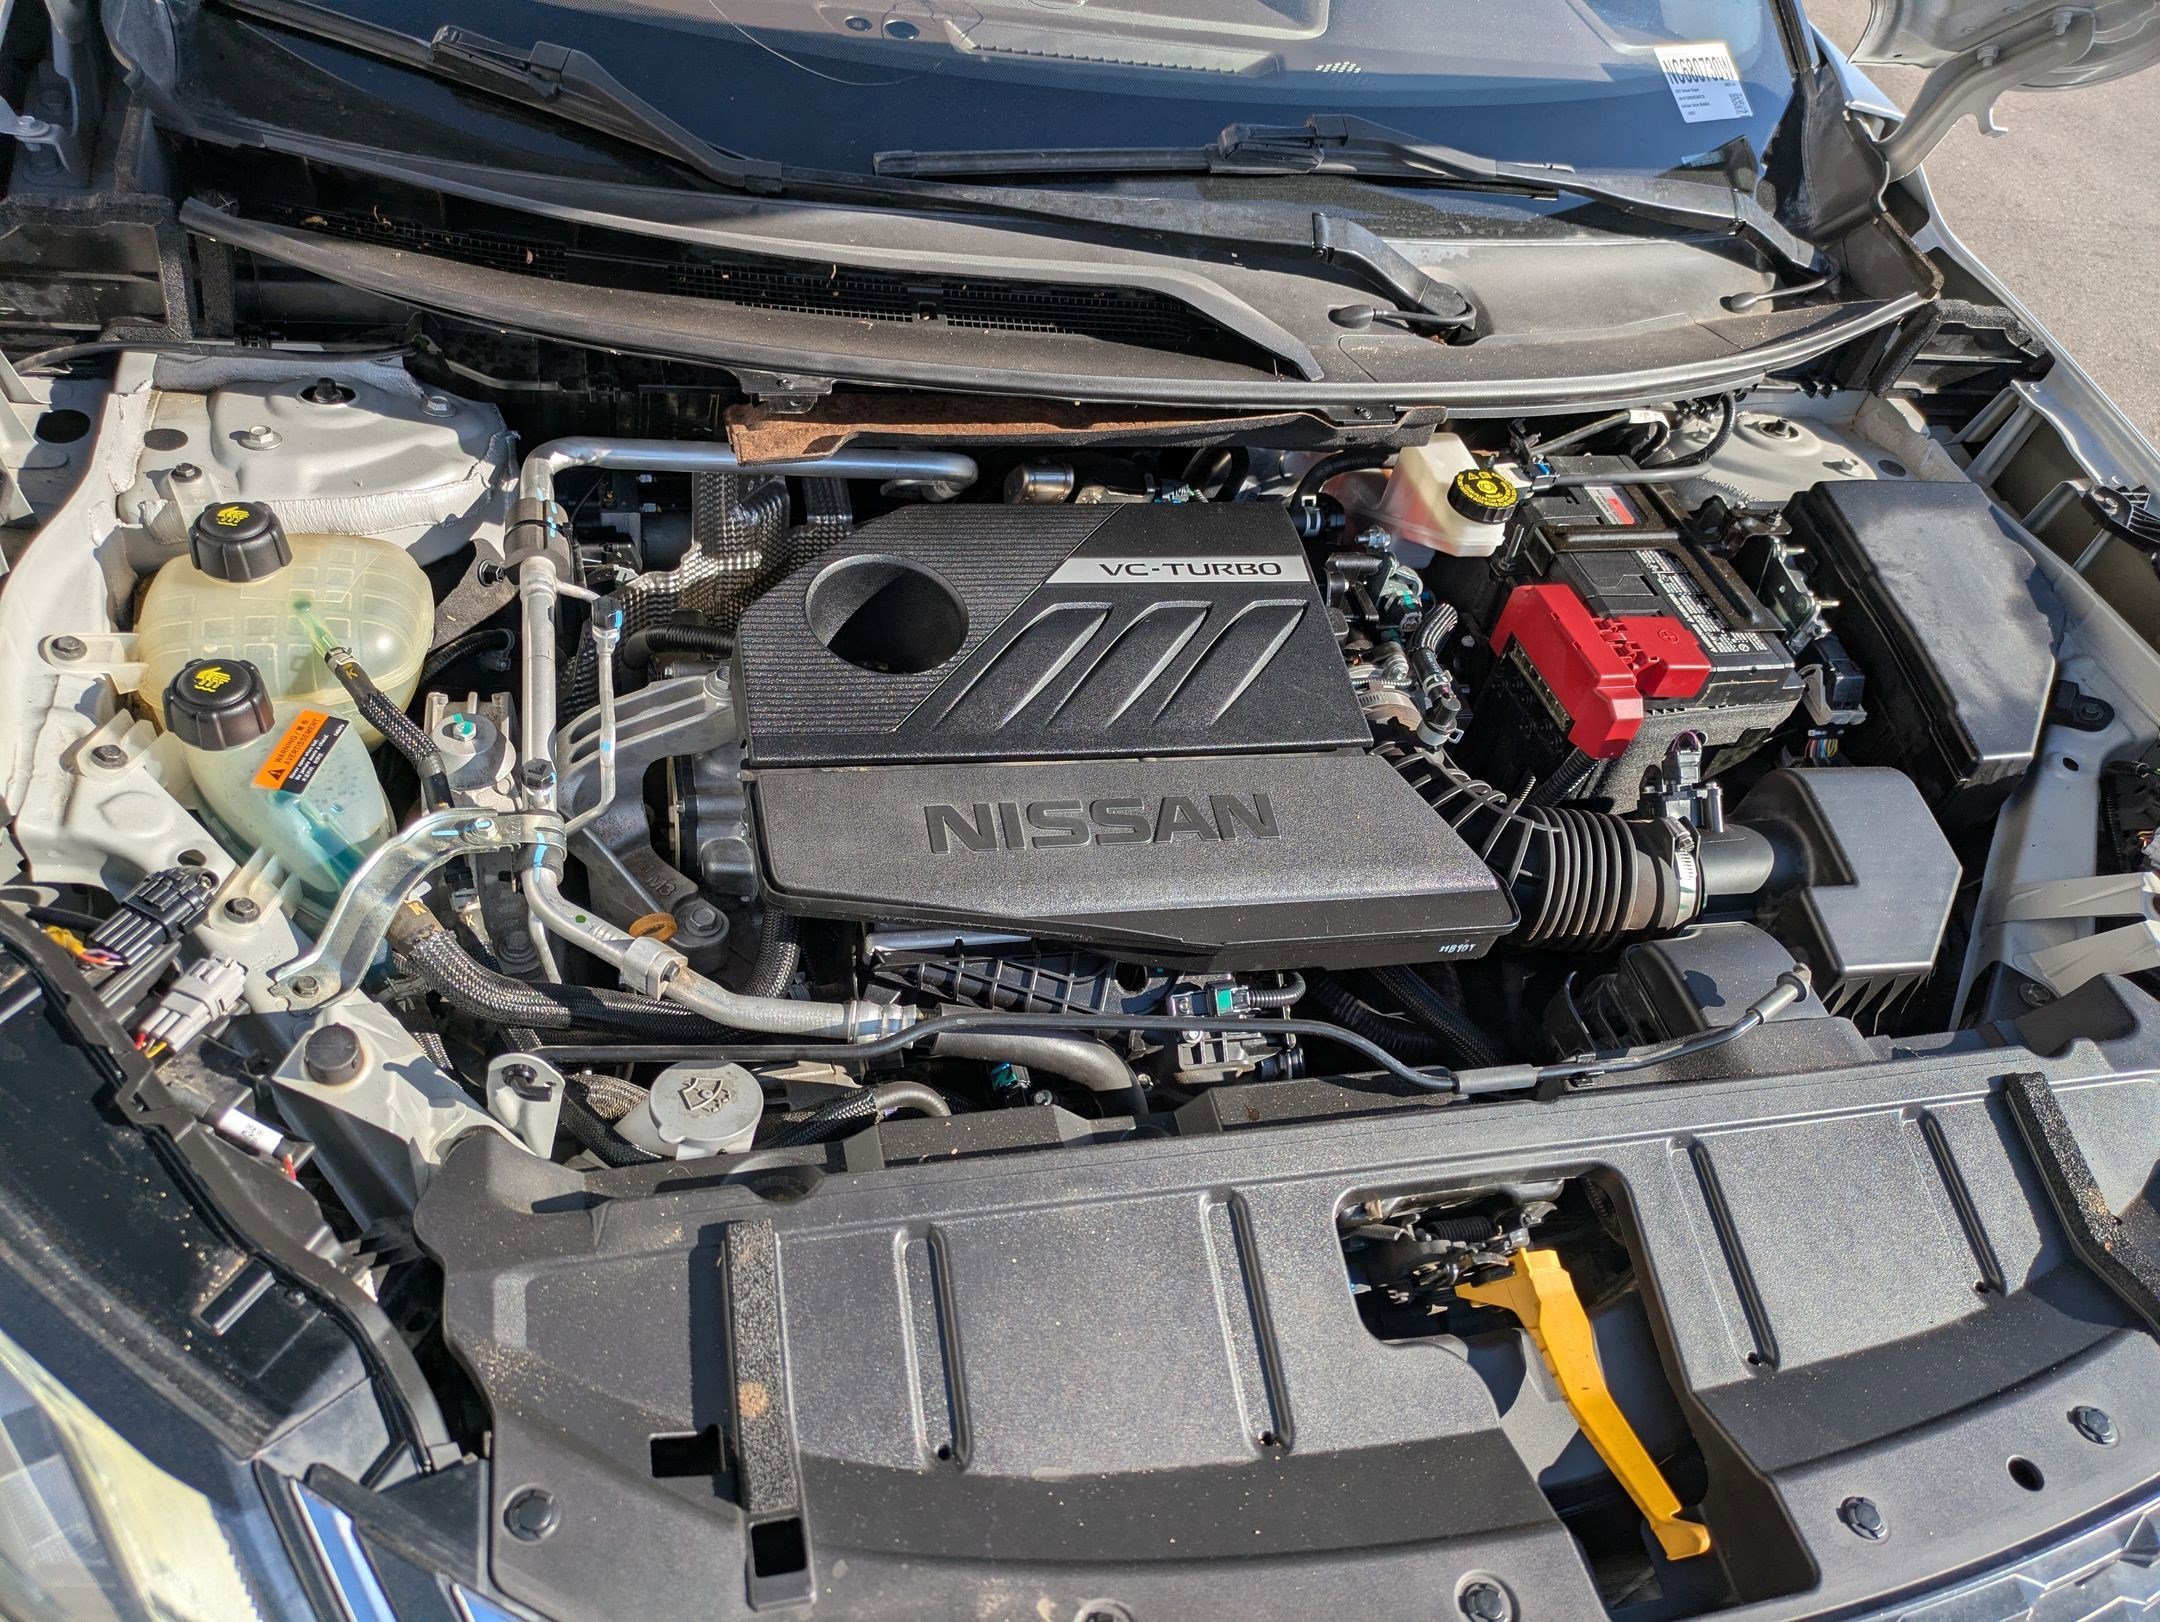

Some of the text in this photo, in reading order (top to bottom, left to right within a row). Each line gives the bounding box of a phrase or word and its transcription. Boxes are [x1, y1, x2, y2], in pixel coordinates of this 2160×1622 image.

[1100, 562, 1282, 576] VC-TURBO
[275, 735, 298, 762] WARNING
[284, 718, 320, 765] AVERTISSEMENT
[924, 793, 1281, 855] NISSAN
